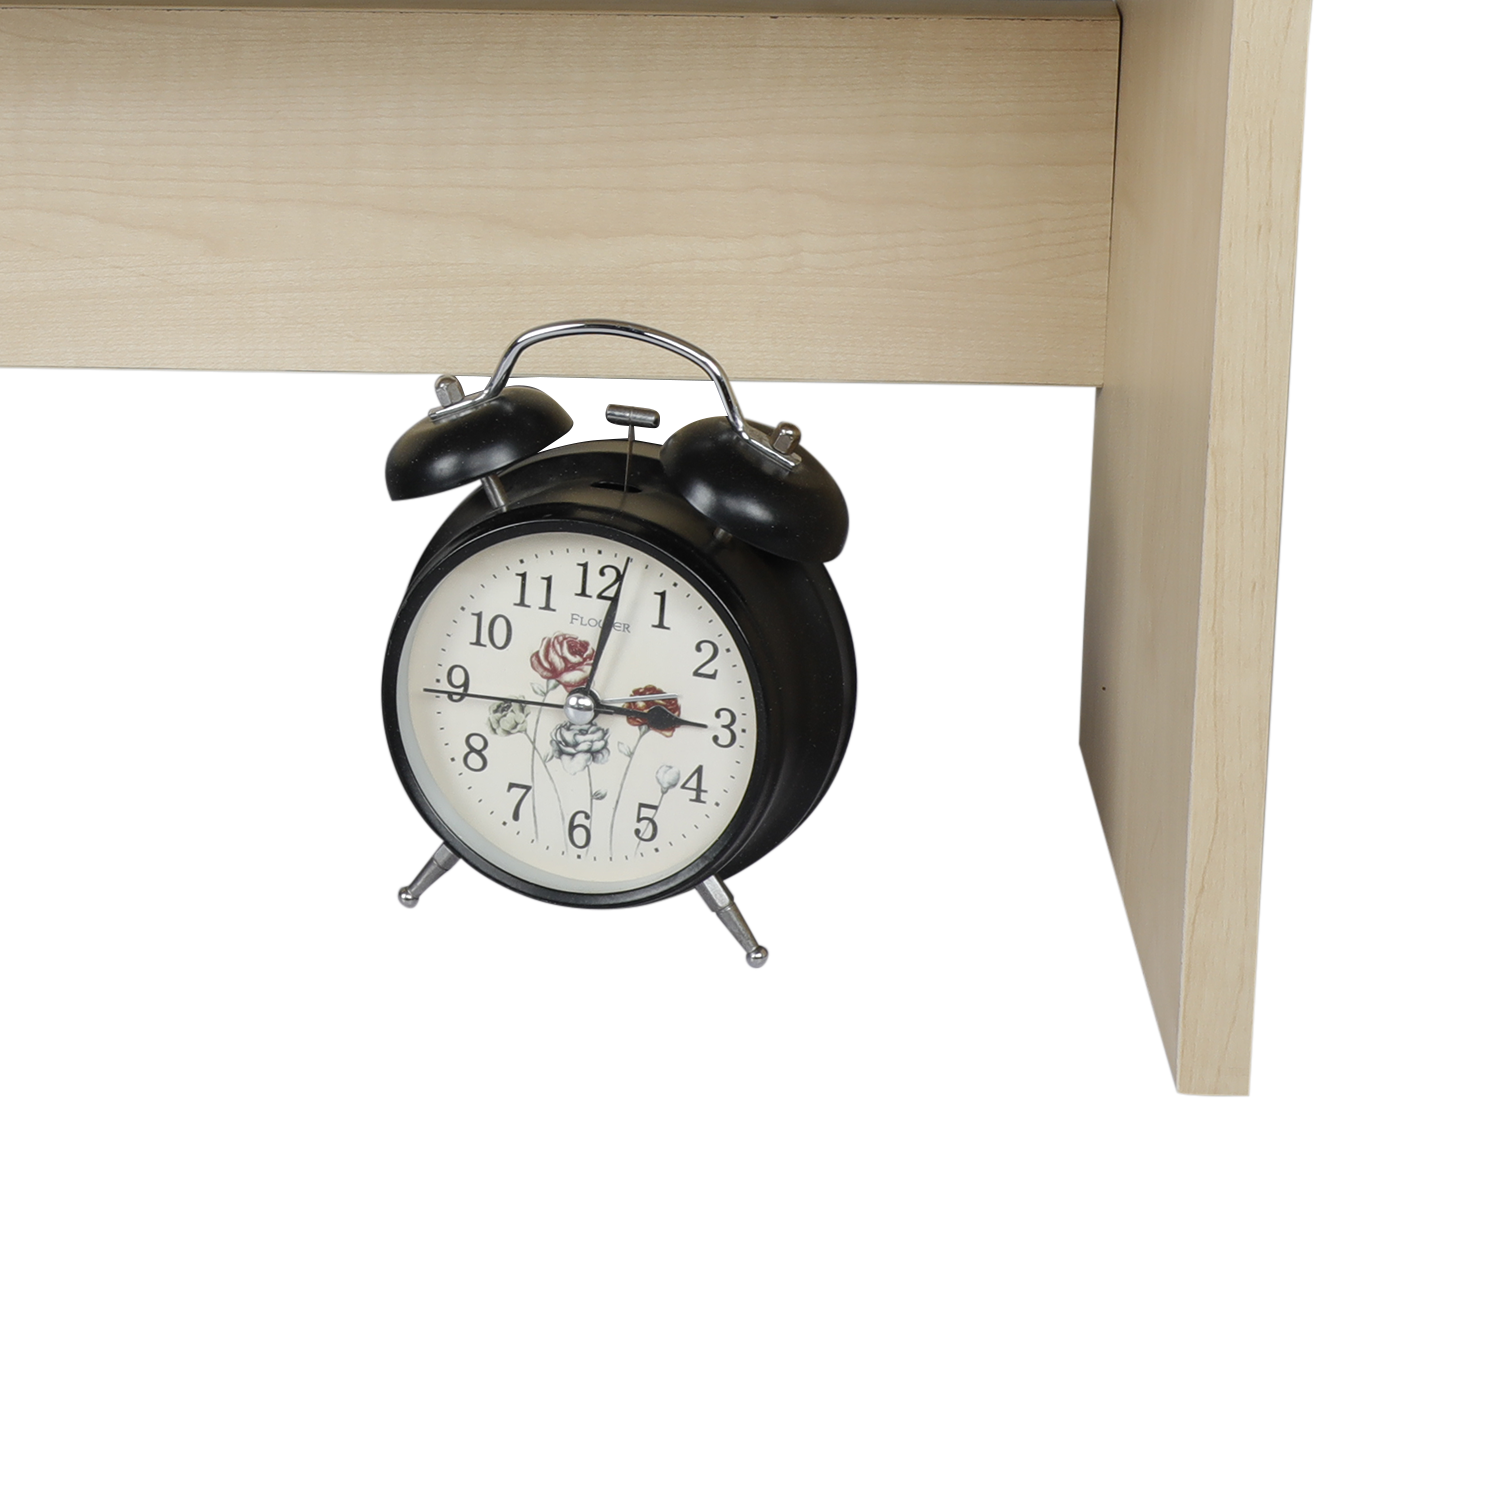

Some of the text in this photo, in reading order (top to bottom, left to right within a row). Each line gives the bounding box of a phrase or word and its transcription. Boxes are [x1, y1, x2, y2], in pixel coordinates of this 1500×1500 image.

[512, 572, 558, 612] 11
[572, 561, 623, 601] 12
[468, 611, 513, 650] 10
[650, 590, 672, 631] 1
[692, 639, 719, 680] 2
[445, 664, 471, 702] 9
[711, 707, 738, 749] 3
[462, 732, 489, 772] 8
[505, 782, 532, 822] 7
[680, 764, 709, 804] 4
[567, 810, 592, 849] 6
[633, 803, 660, 842] 5
